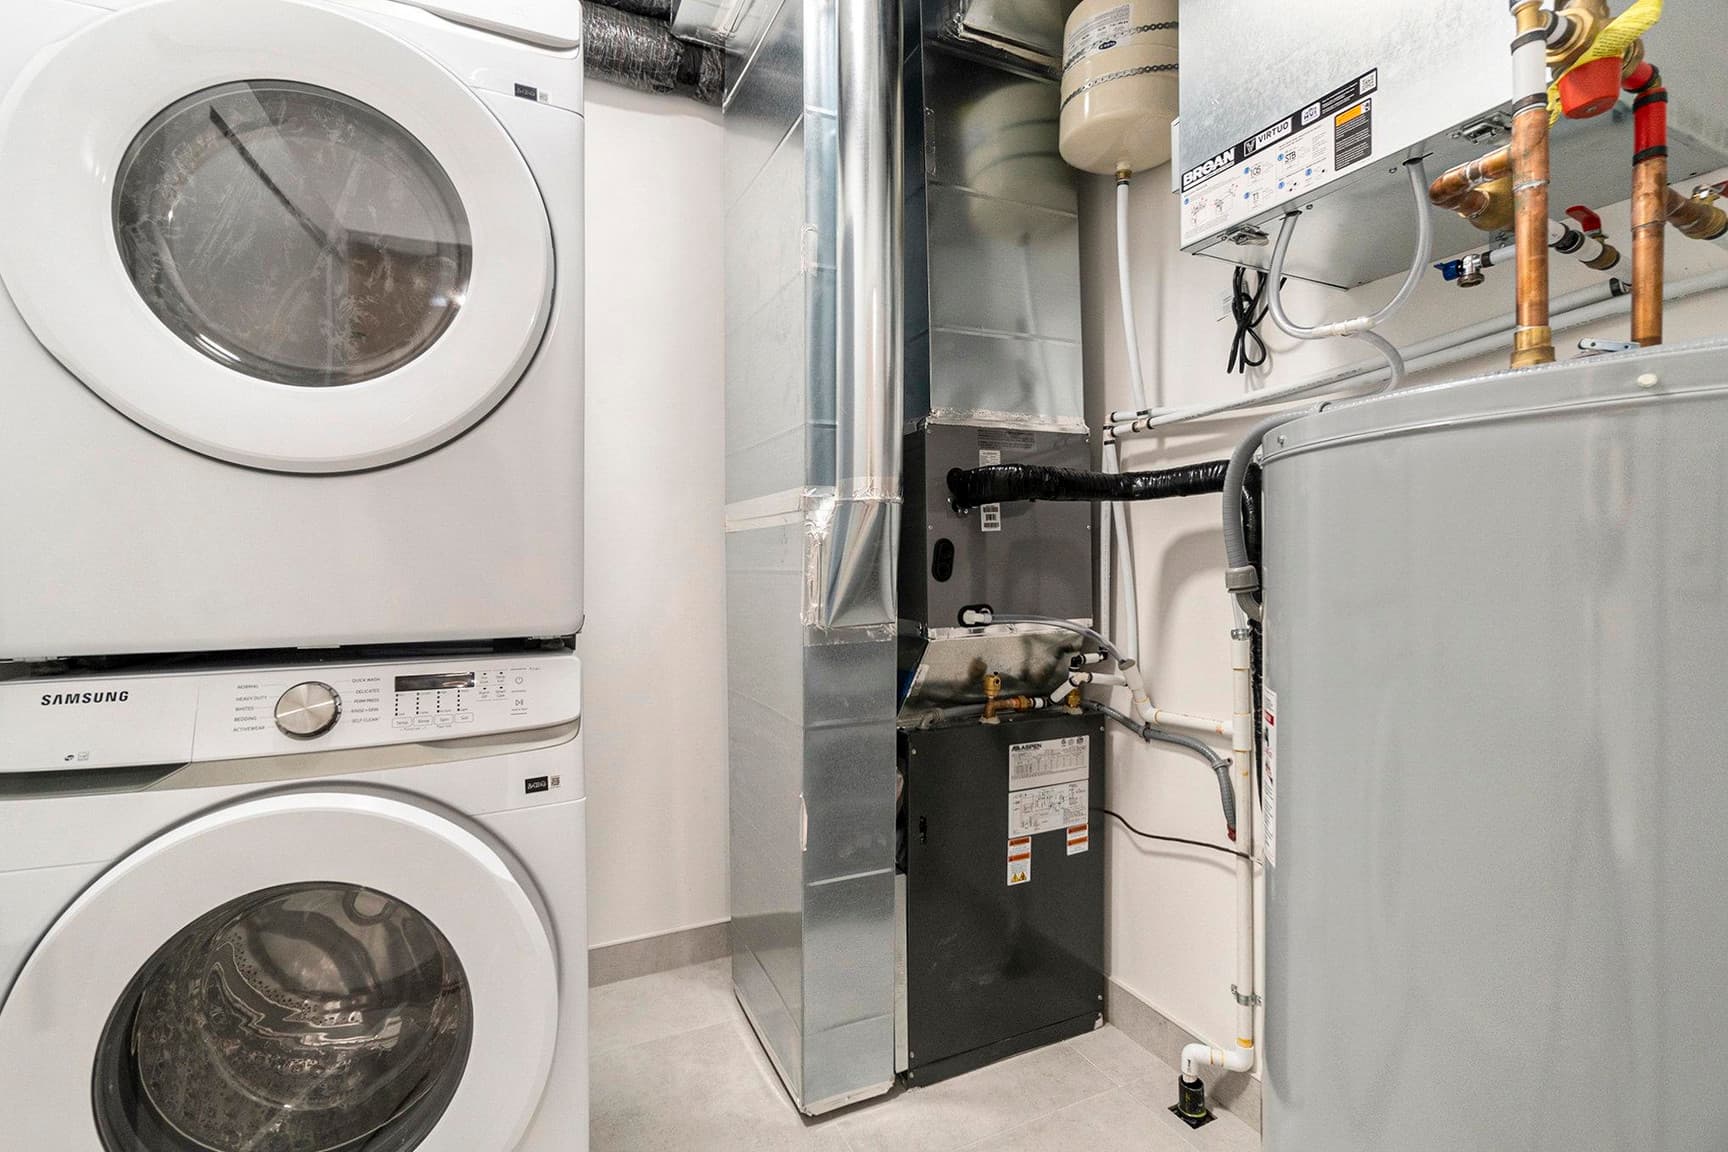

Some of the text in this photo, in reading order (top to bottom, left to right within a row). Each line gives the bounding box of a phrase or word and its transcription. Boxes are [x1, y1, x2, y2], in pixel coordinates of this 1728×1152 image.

[1183, 147, 1236, 187] BROAN
[1257, 121, 1289, 143] VIRTUO
[41, 690, 129, 706] SAMSUNG
